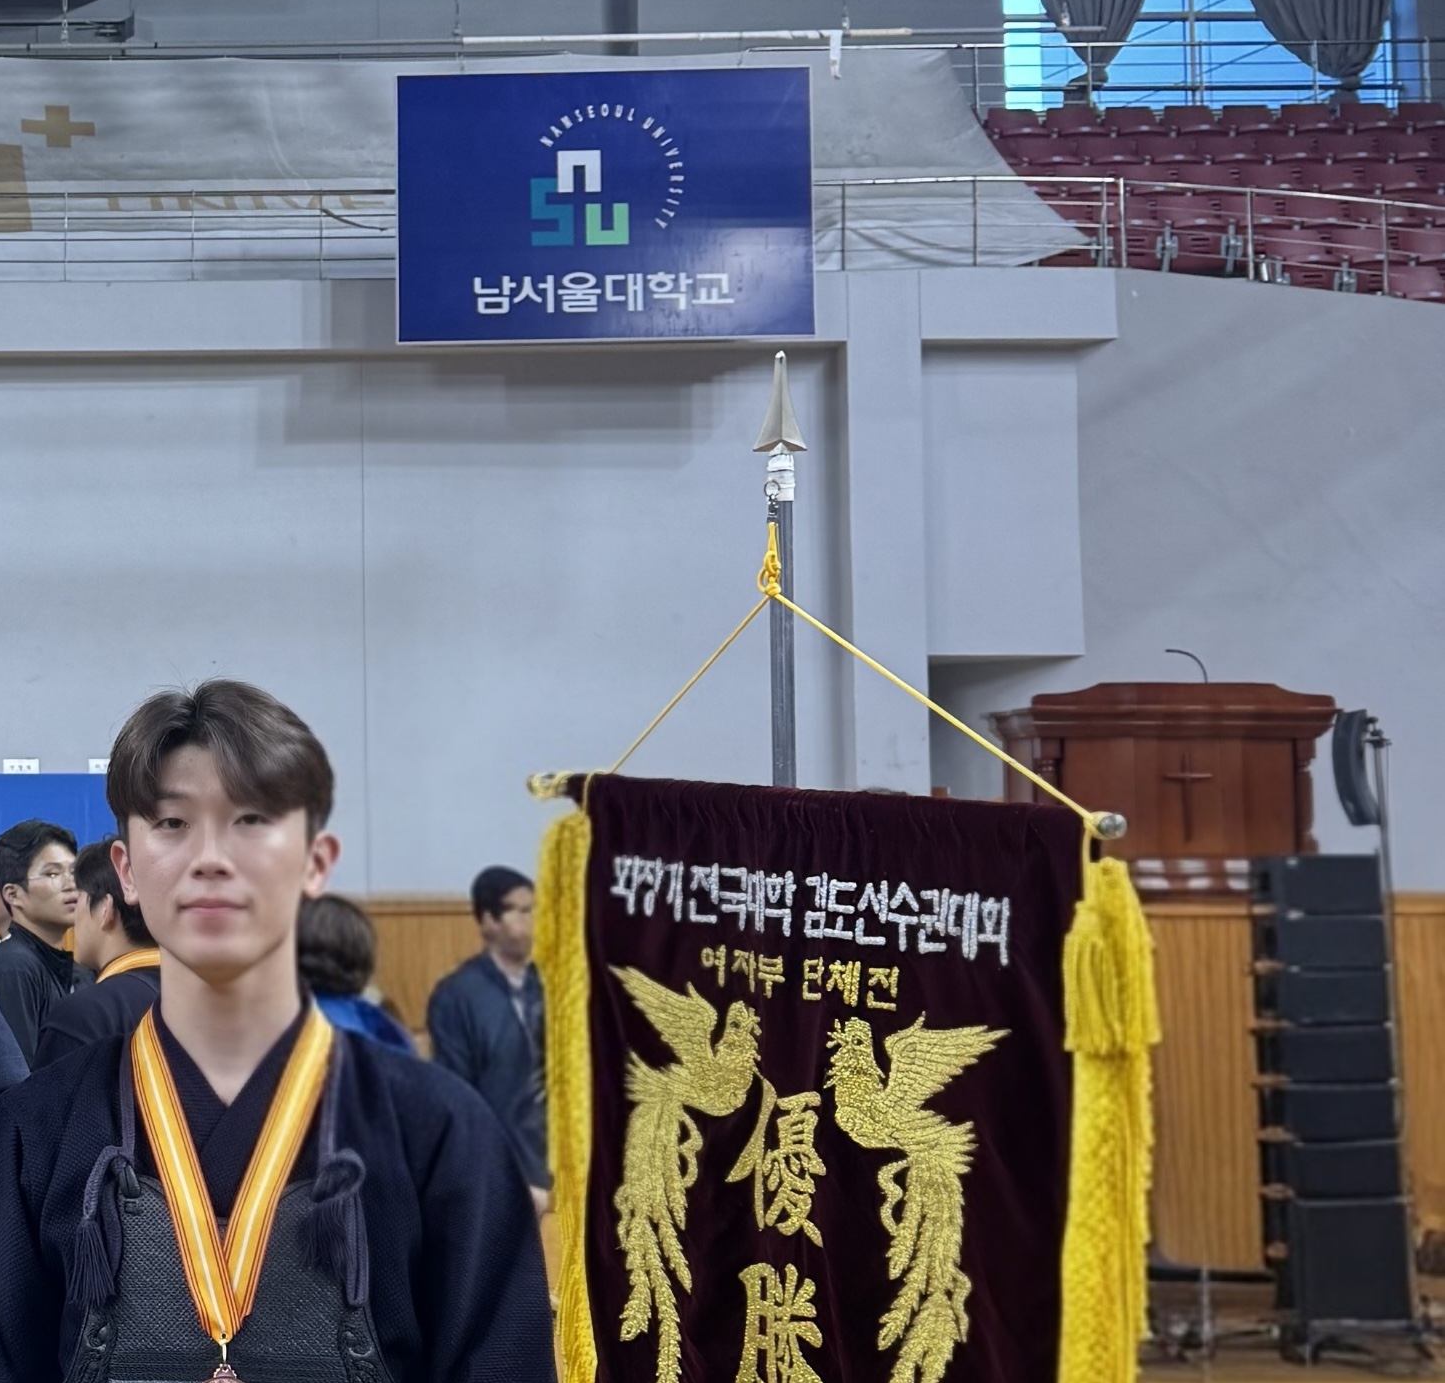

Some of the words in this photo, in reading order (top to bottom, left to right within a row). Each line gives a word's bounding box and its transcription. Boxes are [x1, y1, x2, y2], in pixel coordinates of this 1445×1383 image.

[642, 116, 684, 229] UNIVERSITY
[473, 272, 735, 314] 남서울대학교
[689, 863, 797, 937] 전국대학
[804, 872, 1010, 966] 검도선수권대회
[701, 945, 785, 999] 여자부
[803, 957, 899, 1011] 단체전
